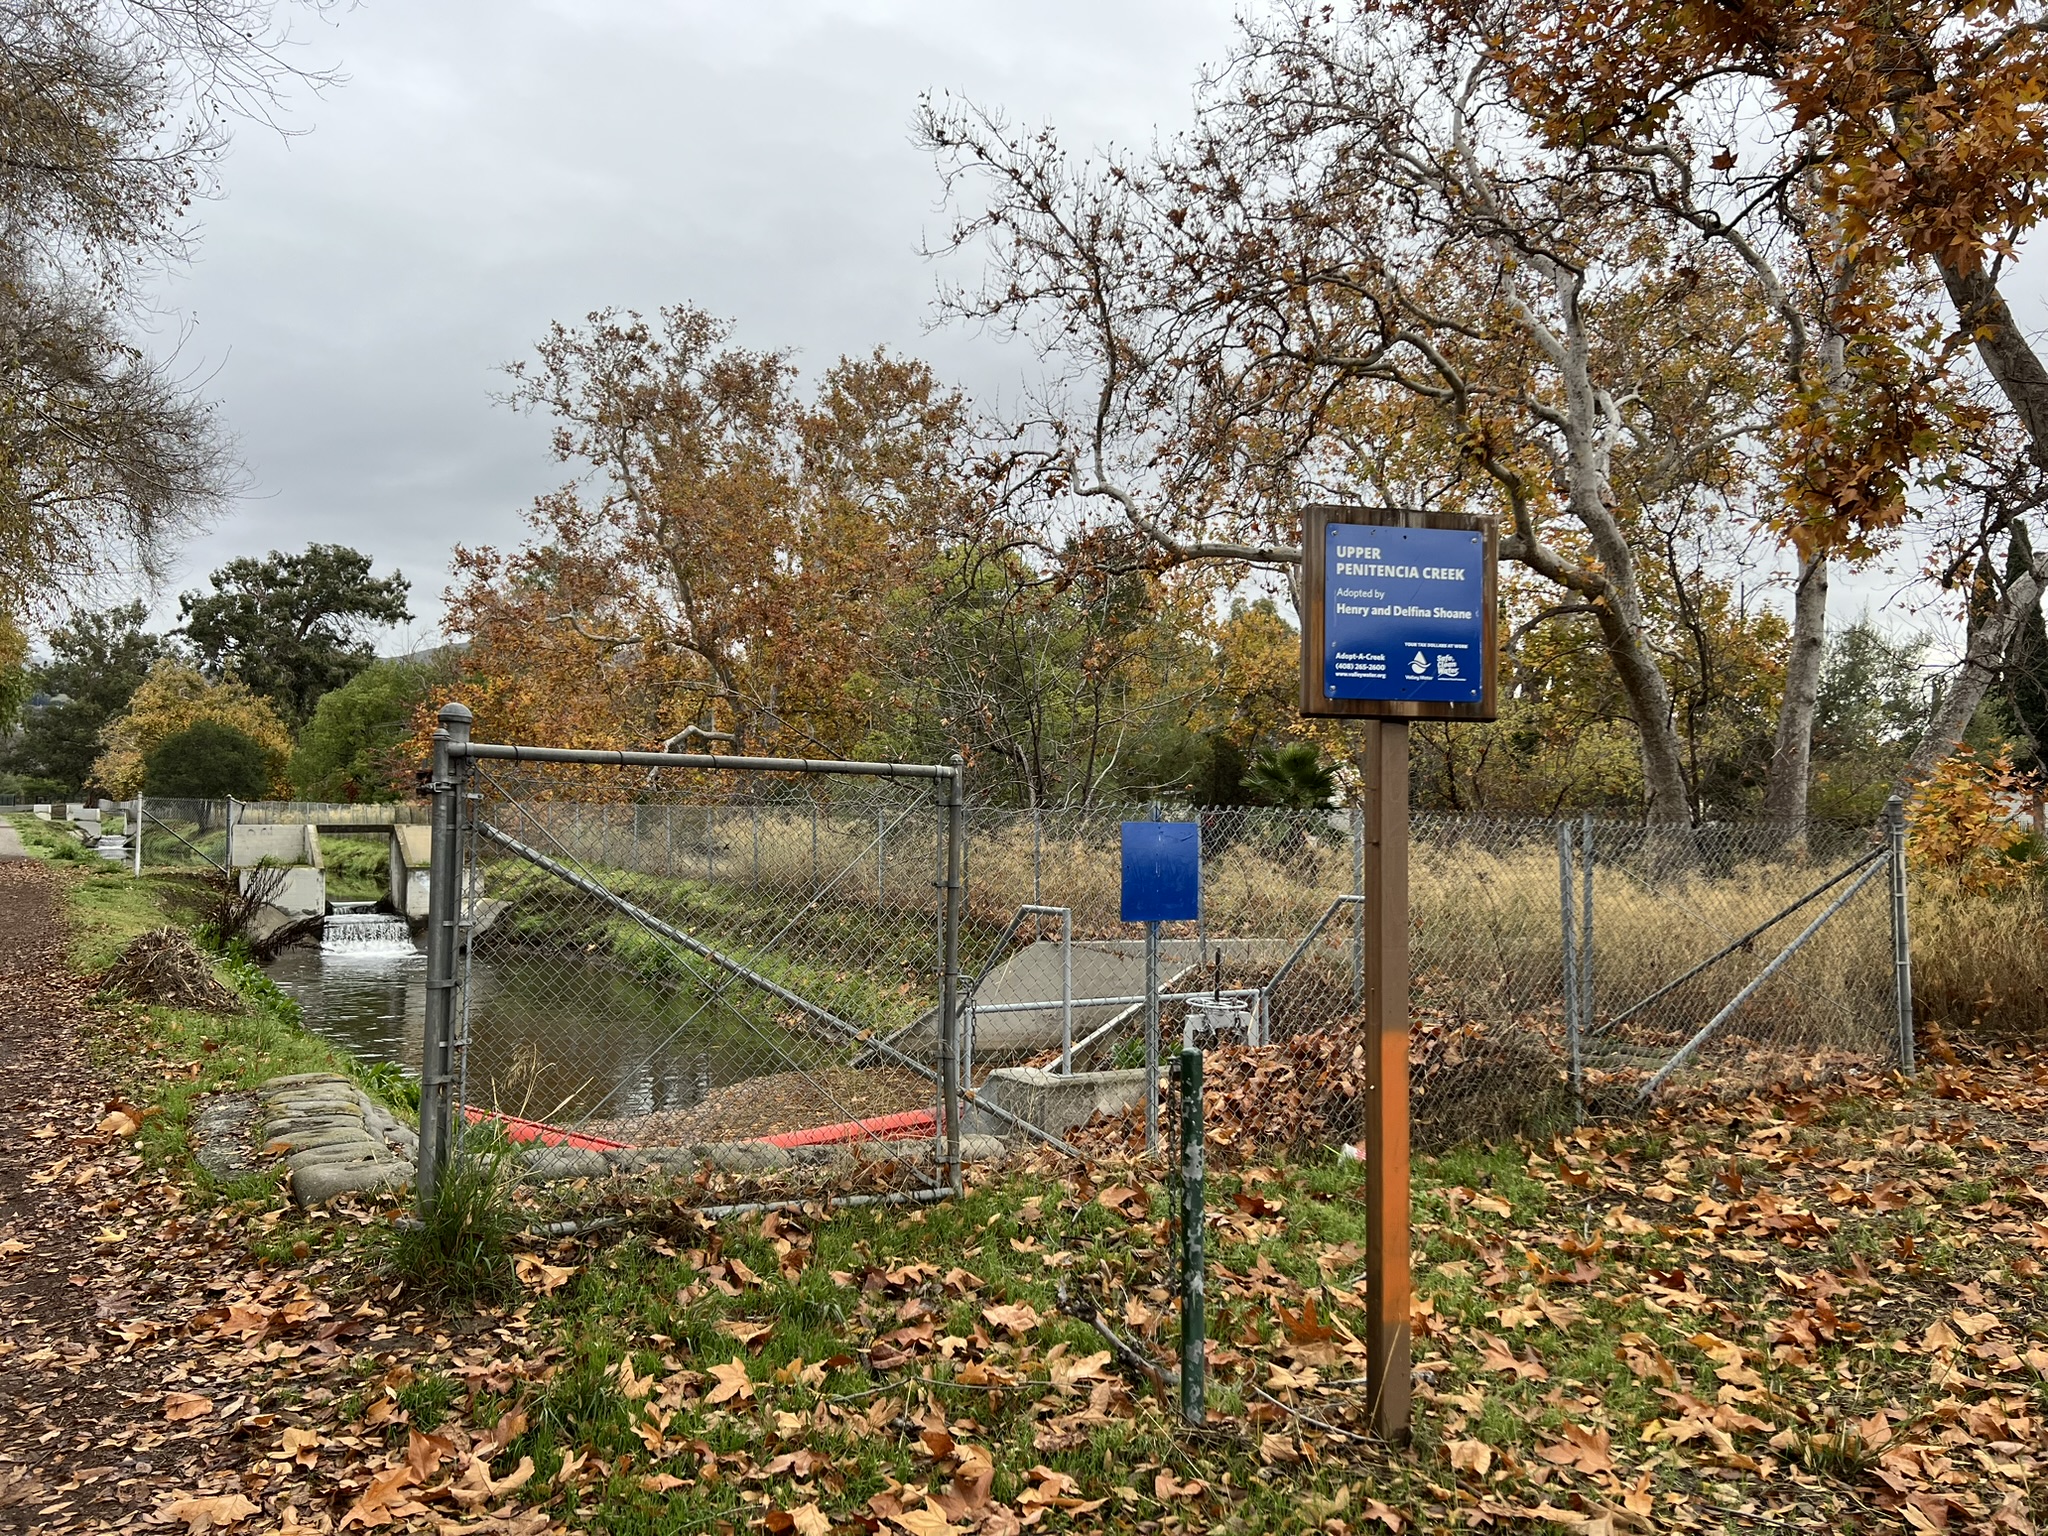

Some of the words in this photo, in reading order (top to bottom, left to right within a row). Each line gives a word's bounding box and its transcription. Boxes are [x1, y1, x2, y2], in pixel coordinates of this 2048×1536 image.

[1336, 545, 1381, 560] UPPER
[1336, 562, 1420, 579] PENITENCIA
[1422, 567, 1465, 581] CREEK
[1336, 587, 1373, 599] Adopted
[1374, 589, 1385, 600] by
[1336, 603, 1370, 617] Henry
[1371, 605, 1391, 616] and
[1393, 605, 1431, 618] Delfina
[1433, 607, 1472, 620] Shoane
[1335, 652, 1386, 661] Adopt-A-Creek
[1335, 662, 1354, 671] (408)
[1354, 663, 1386, 671] 265-2600
[1335, 671, 1386, 679] www.valleywater.org
